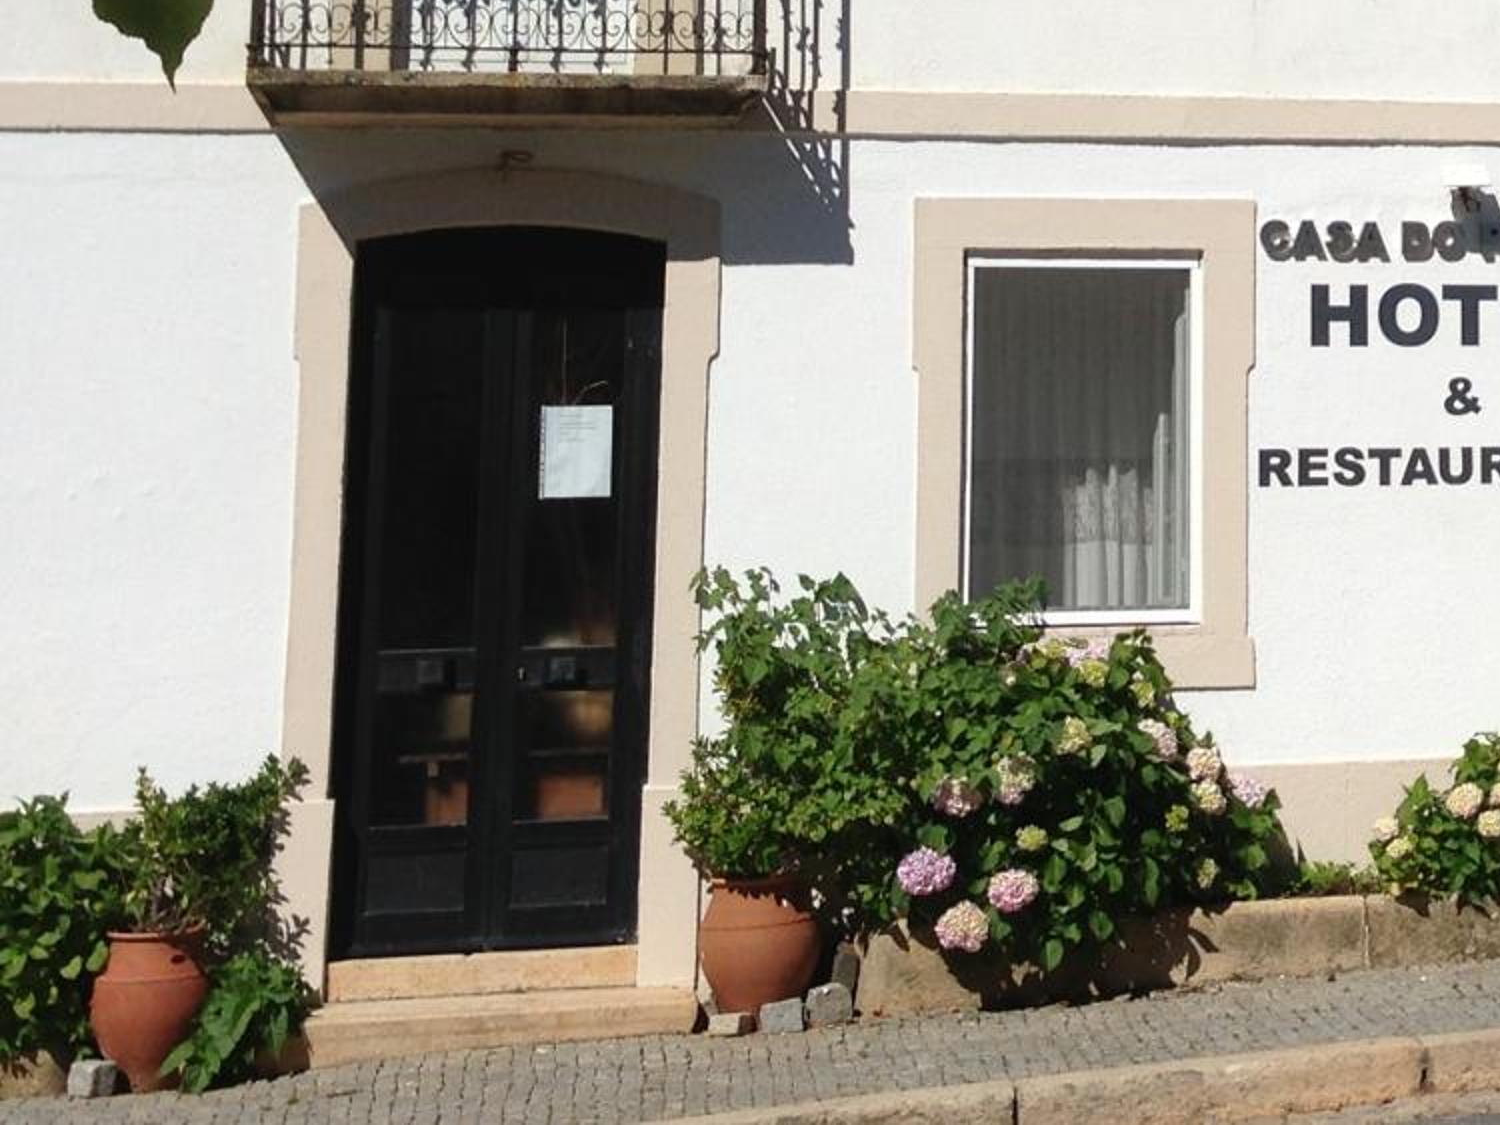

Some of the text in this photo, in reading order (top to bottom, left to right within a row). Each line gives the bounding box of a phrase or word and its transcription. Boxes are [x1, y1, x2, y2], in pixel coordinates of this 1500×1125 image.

[1260, 220, 1391, 263] CASA
[1401, 221, 1467, 263] DO
[1443, 377, 1482, 416] &
